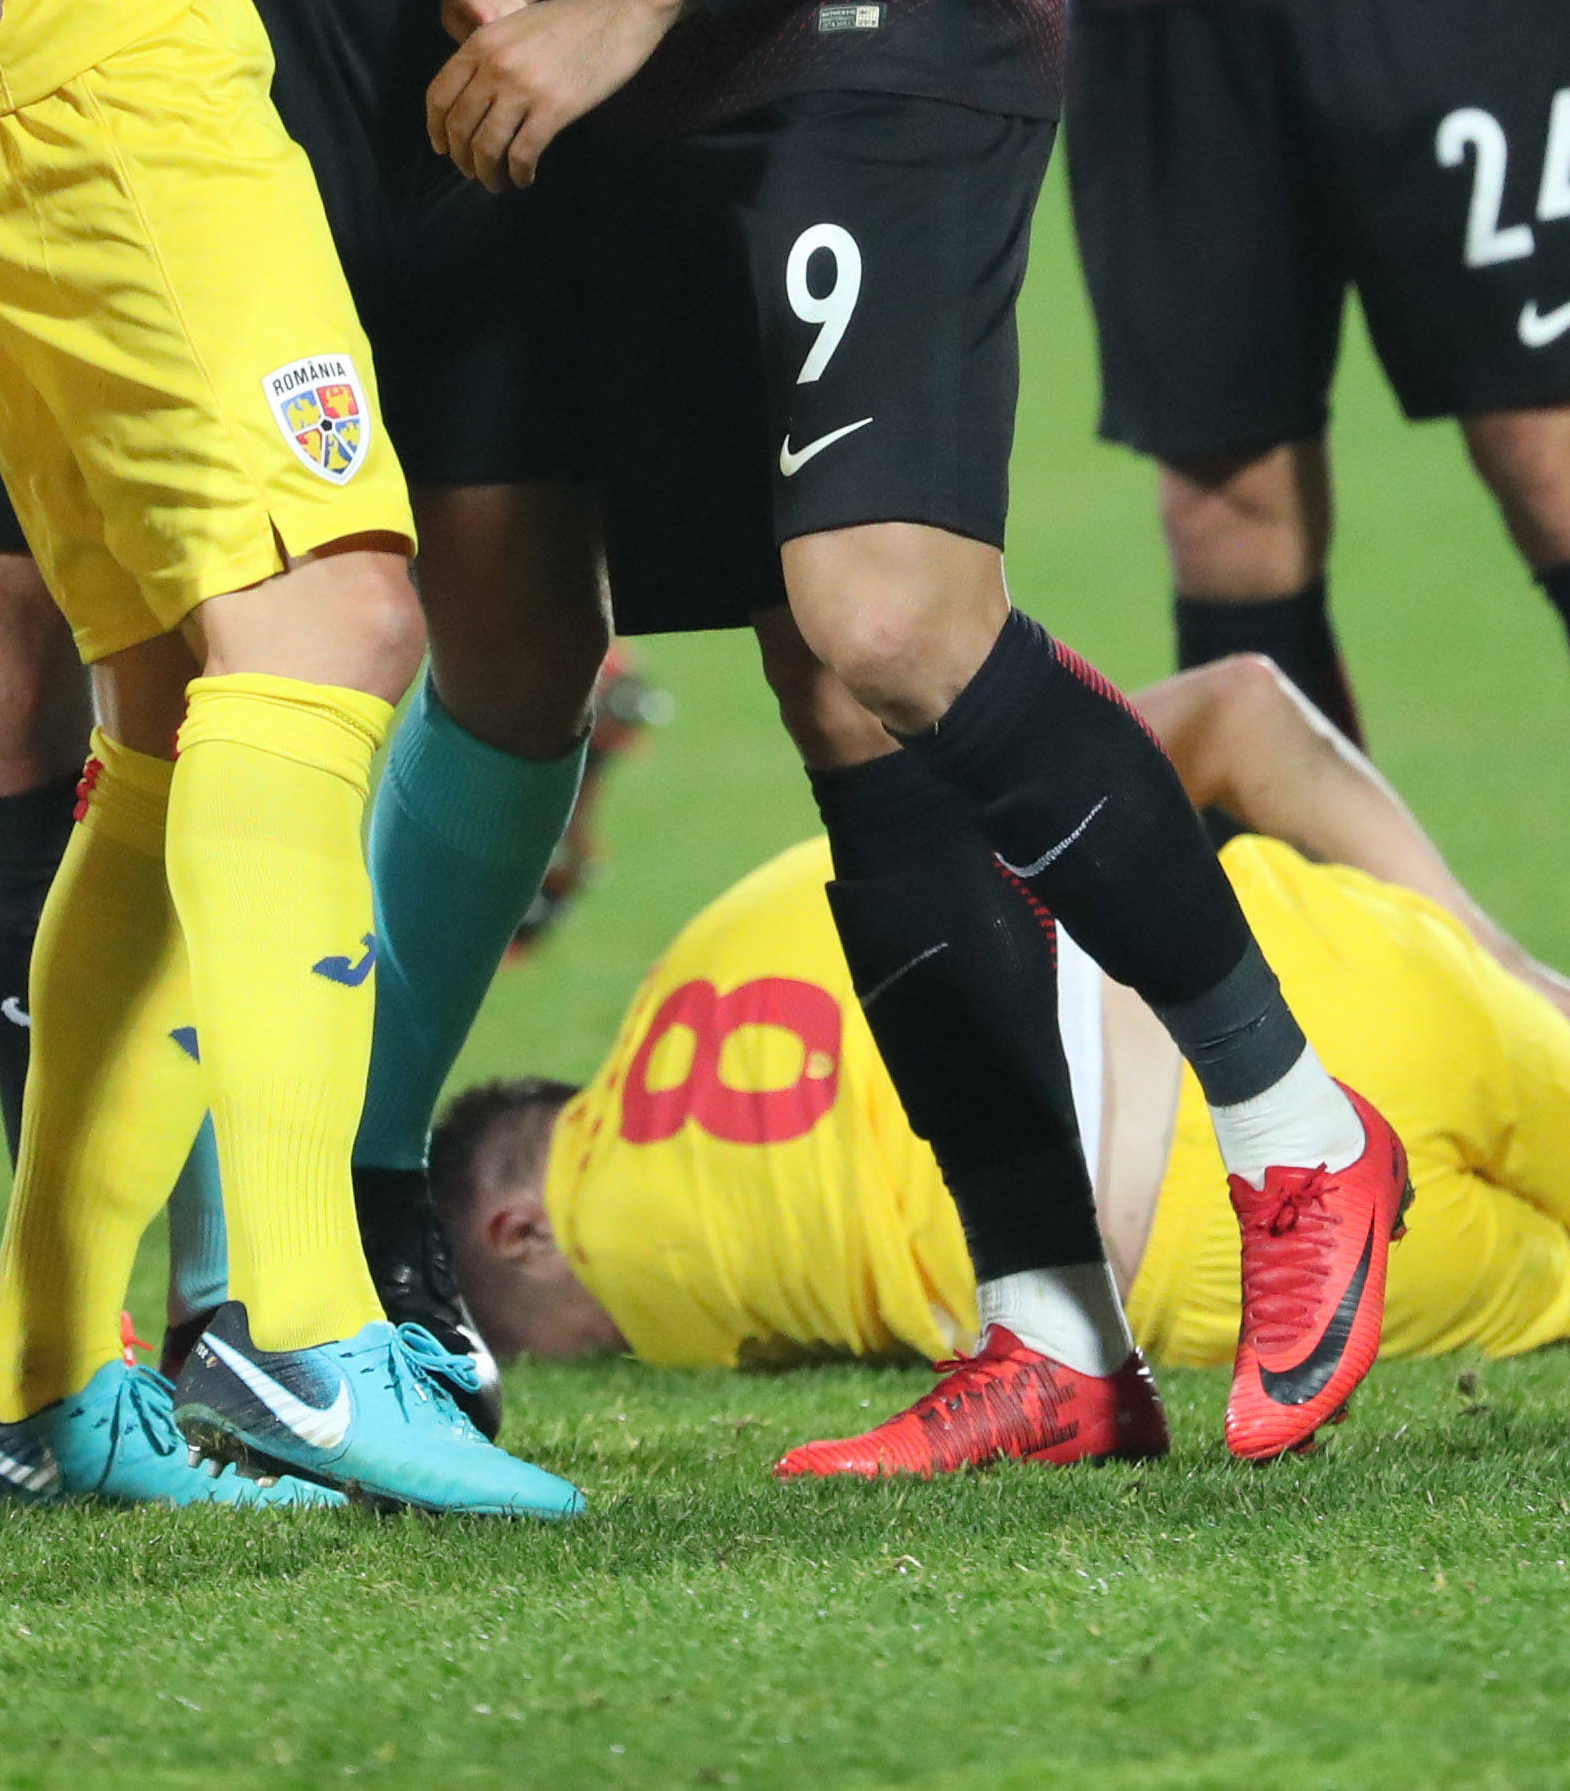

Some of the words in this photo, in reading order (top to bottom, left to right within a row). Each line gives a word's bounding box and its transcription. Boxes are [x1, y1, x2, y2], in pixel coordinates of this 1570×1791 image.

[272, 359, 348, 397] ROMÂNIA
[785, 223, 864, 385] 9
[618, 977, 843, 1146] 8
